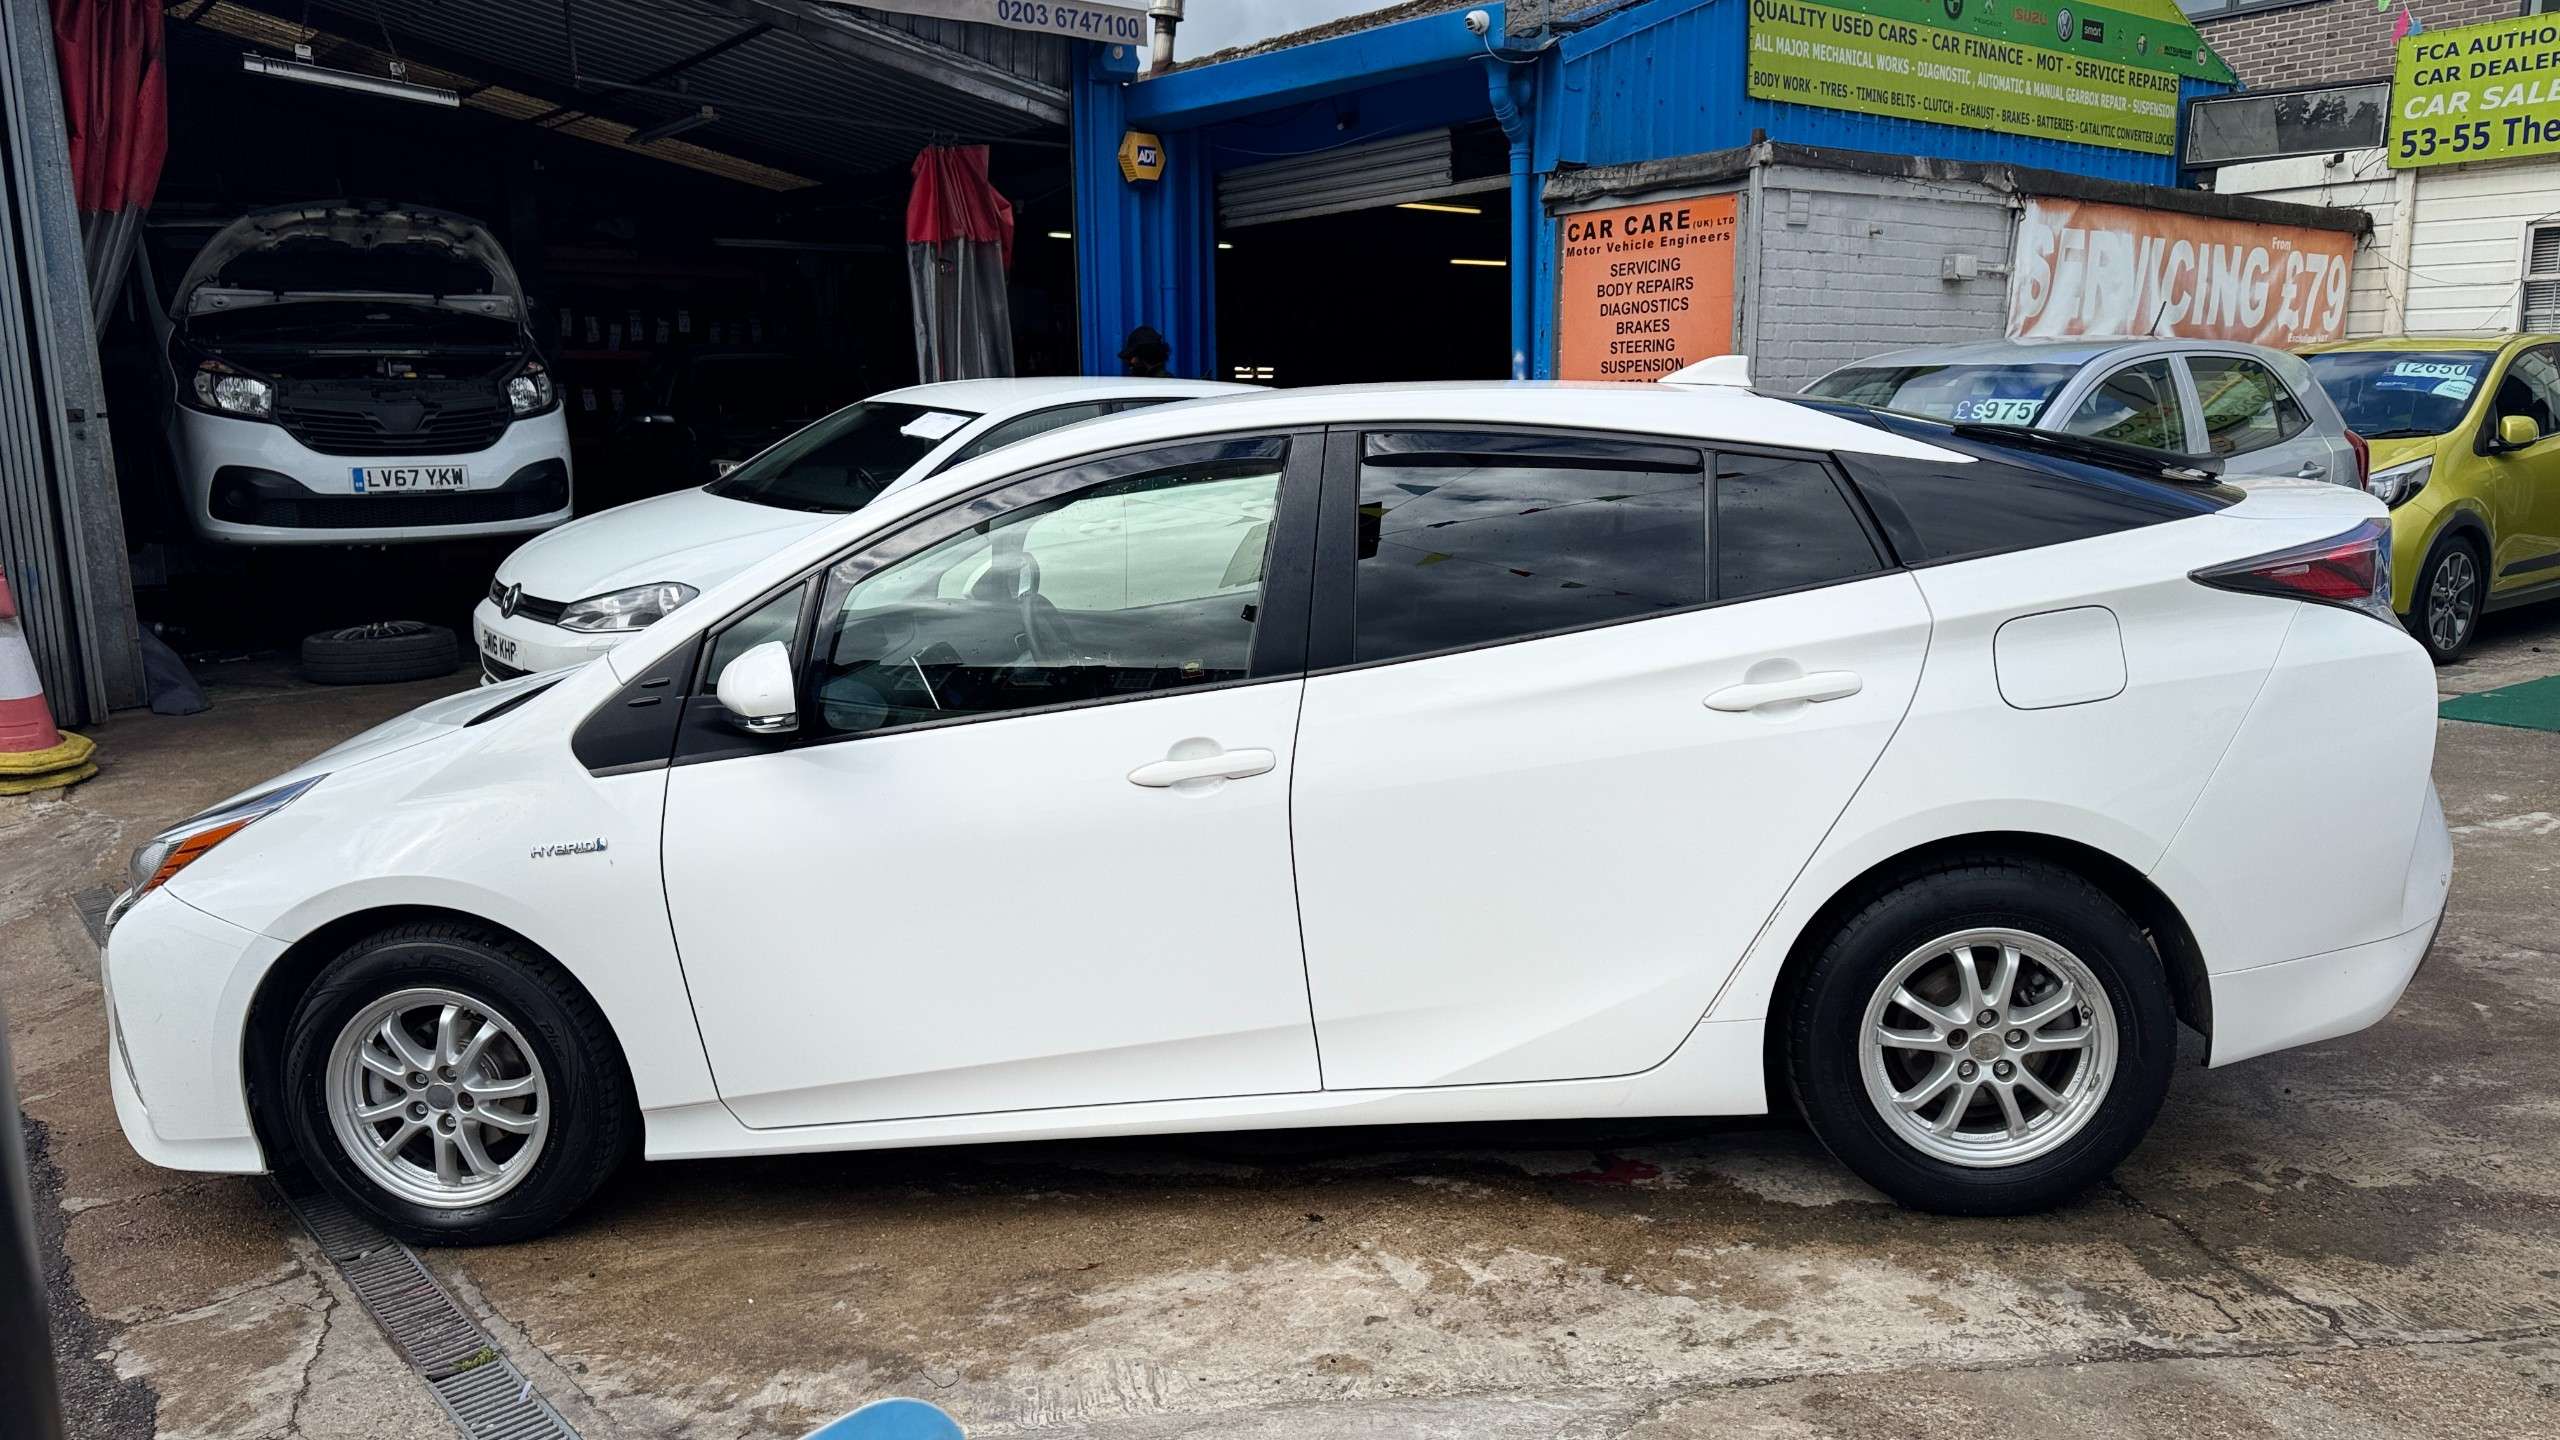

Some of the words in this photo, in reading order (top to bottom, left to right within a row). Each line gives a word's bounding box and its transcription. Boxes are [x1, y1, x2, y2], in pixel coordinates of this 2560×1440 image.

[998, 0, 1048, 25] 0203
[1056, 8, 1139, 38] 6747100
[1753, 0, 1827, 29] QUALITY
[1832, 13, 1874, 37] USED
[1878, 22, 1918, 46] CARS
[1932, 33, 1960, 54] CAR
[1964, 39, 2024, 66] FINANCE
[2036, 53, 2063, 72] MOT
[2075, 60, 2125, 85] SERVICE
[2128, 71, 2177, 93] REPAIRS
[2416, 42, 2460, 62] FCA
[2468, 26, 2560, 55] AUTHO
[1754, 32, 1774, 53] ALL
[1776, 36, 1810, 59] MAJOR
[1812, 44, 1874, 69] MECHANICAL
[1876, 55, 1910, 75] WORKS
[1976, 72, 2025, 95] AUTOMATIC
[2025, 80, 2032, 95] &
[2034, 82, 2064, 101] MANUAL
[2066, 88, 2099, 107] GEARBOX
[2100, 92, 2127, 112] REPAIR
[2133, 98, 2175, 119] SUSPENSION
[2414, 66, 2461, 86] CAR
[1754, 71, 1780, 89] BODY
[1783, 75, 1811, 94] WORK
[1820, 80, 1848, 98] TYRES
[1856, 86, 1888, 104] TIMING
[1891, 91, 1916, 109] BELTS
[1924, 96, 1954, 114] CLUTCH
[1960, 102, 1995, 121] EXHAUST
[2002, 110, 2030, 126] BRAKES
[2036, 114, 2074, 132] BATTERIES
[2080, 121, 2116, 139] CATALYTIC
[2116, 126, 2154, 145] CONVERTER
[2154, 132, 2174, 147] LOCKS
[2404, 91, 2471, 120] CAR
[2400, 120, 2491, 159] 53-55
[2503, 115, 2560, 147] The
[1138, 148, 1157, 164] ADT
[1568, 220, 1613, 243] CAR
[1624, 209, 1691, 236] CARE
[1692, 218, 1714, 230] (UK)
[1717, 216, 1735, 227] LTD
[1566, 246, 1602, 258] Motor
[1606, 239, 1655, 253] Vehicle
[1660, 232, 1731, 249] Engineers
[2272, 236, 2292, 251] From
[1610, 257, 1681, 278] SERVICING
[2014, 222, 2271, 332] SERVICING
[2277, 250, 2347, 332] £79
[1597, 281, 1633, 298] BODY
[1636, 276, 1694, 295] REPAIRS
[1600, 297, 1689, 317] DIAGNOSTICS
[1616, 318, 1670, 335] BRAKES
[1610, 338, 1675, 355] STEERING
[1601, 358, 1684, 374] SUSPENSION
[366, 470, 419, 487] LV67
[425, 468, 463, 486] YKW
[499, 637, 517, 662] KHP
[530, 840, 596, 859] HYBRID
